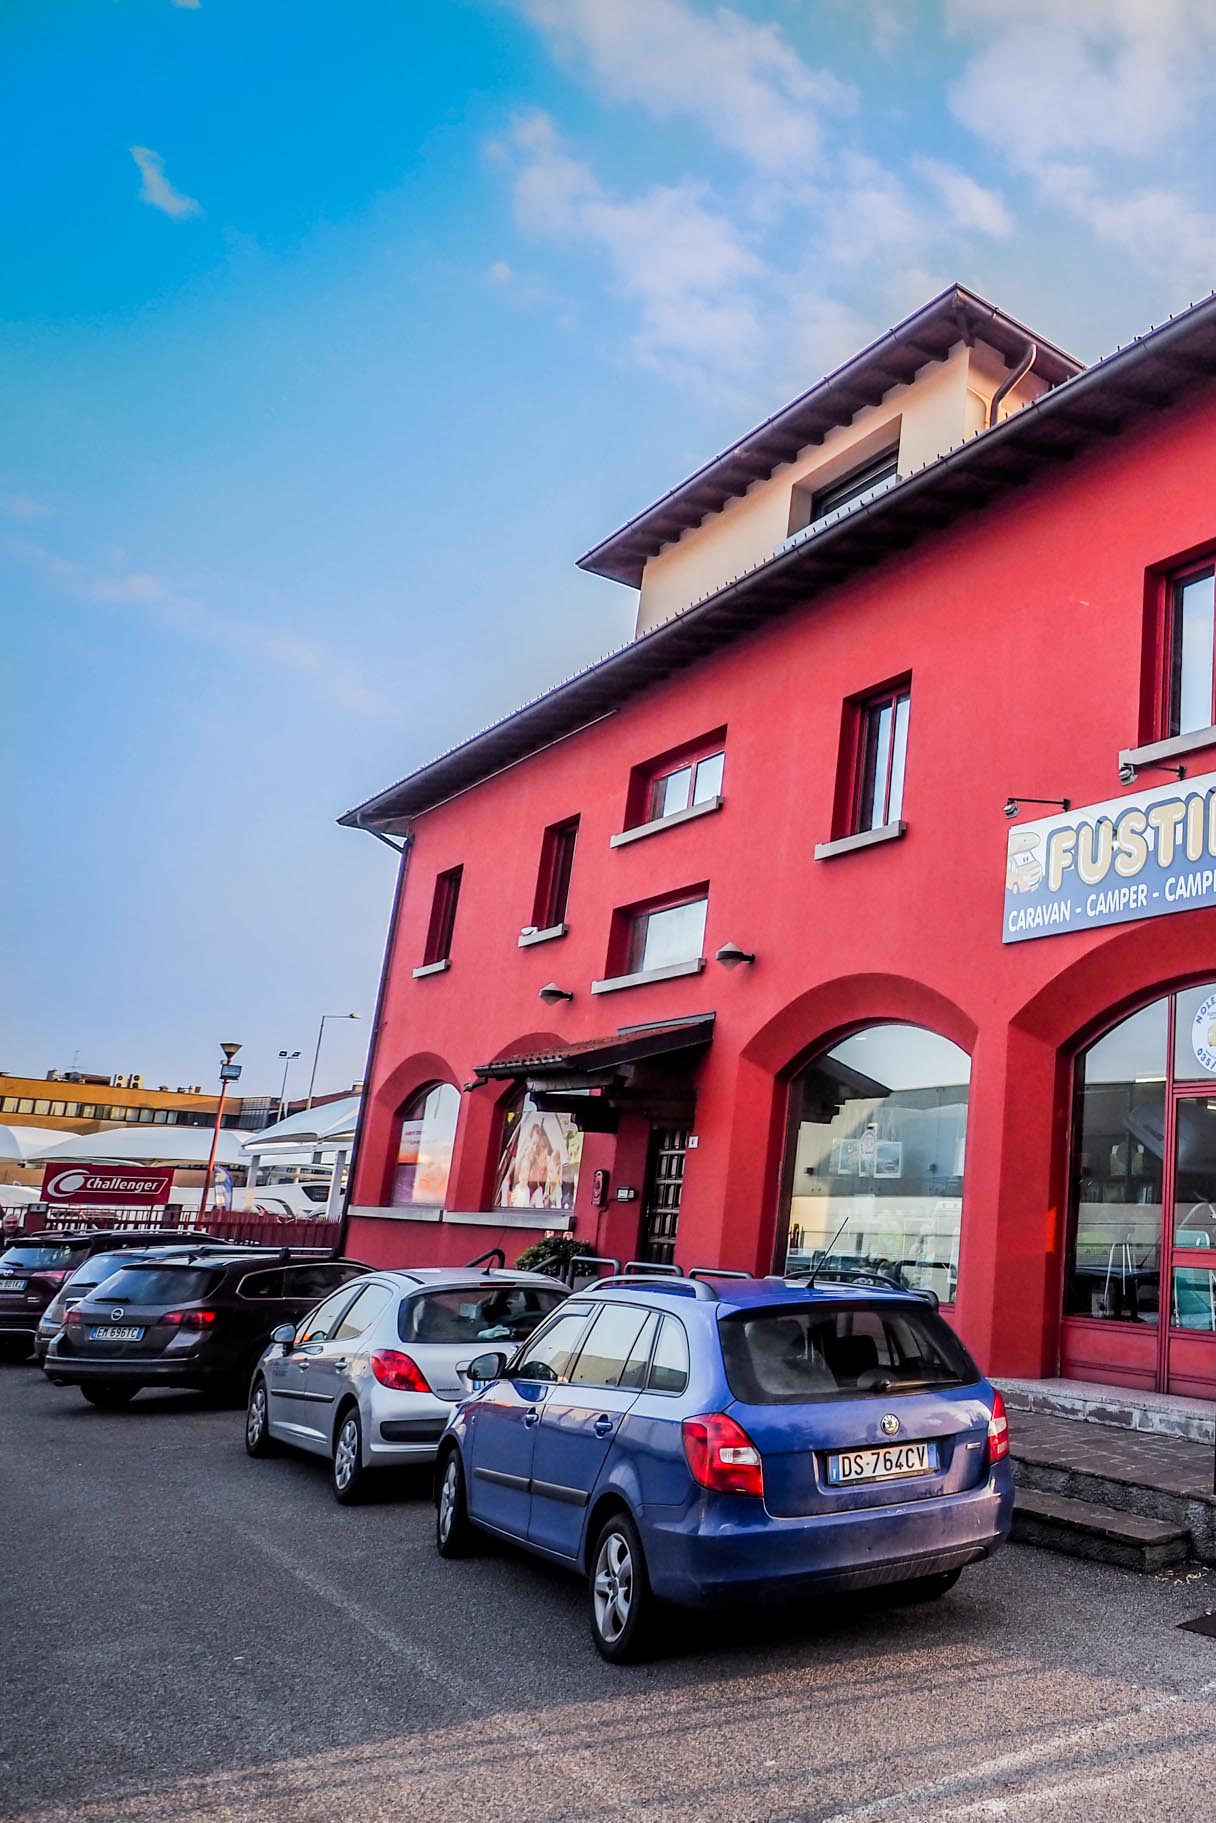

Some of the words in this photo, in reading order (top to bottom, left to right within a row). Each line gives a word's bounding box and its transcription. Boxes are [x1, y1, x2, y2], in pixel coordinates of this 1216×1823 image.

[1008, 899, 1071, 932] CARAVAN
[1086, 884, 1147, 917] CAMPER
[86, 1177, 159, 1193] Challenger
[841, 1454, 864, 1478] DS
[871, 1446, 925, 1474] 764CV
